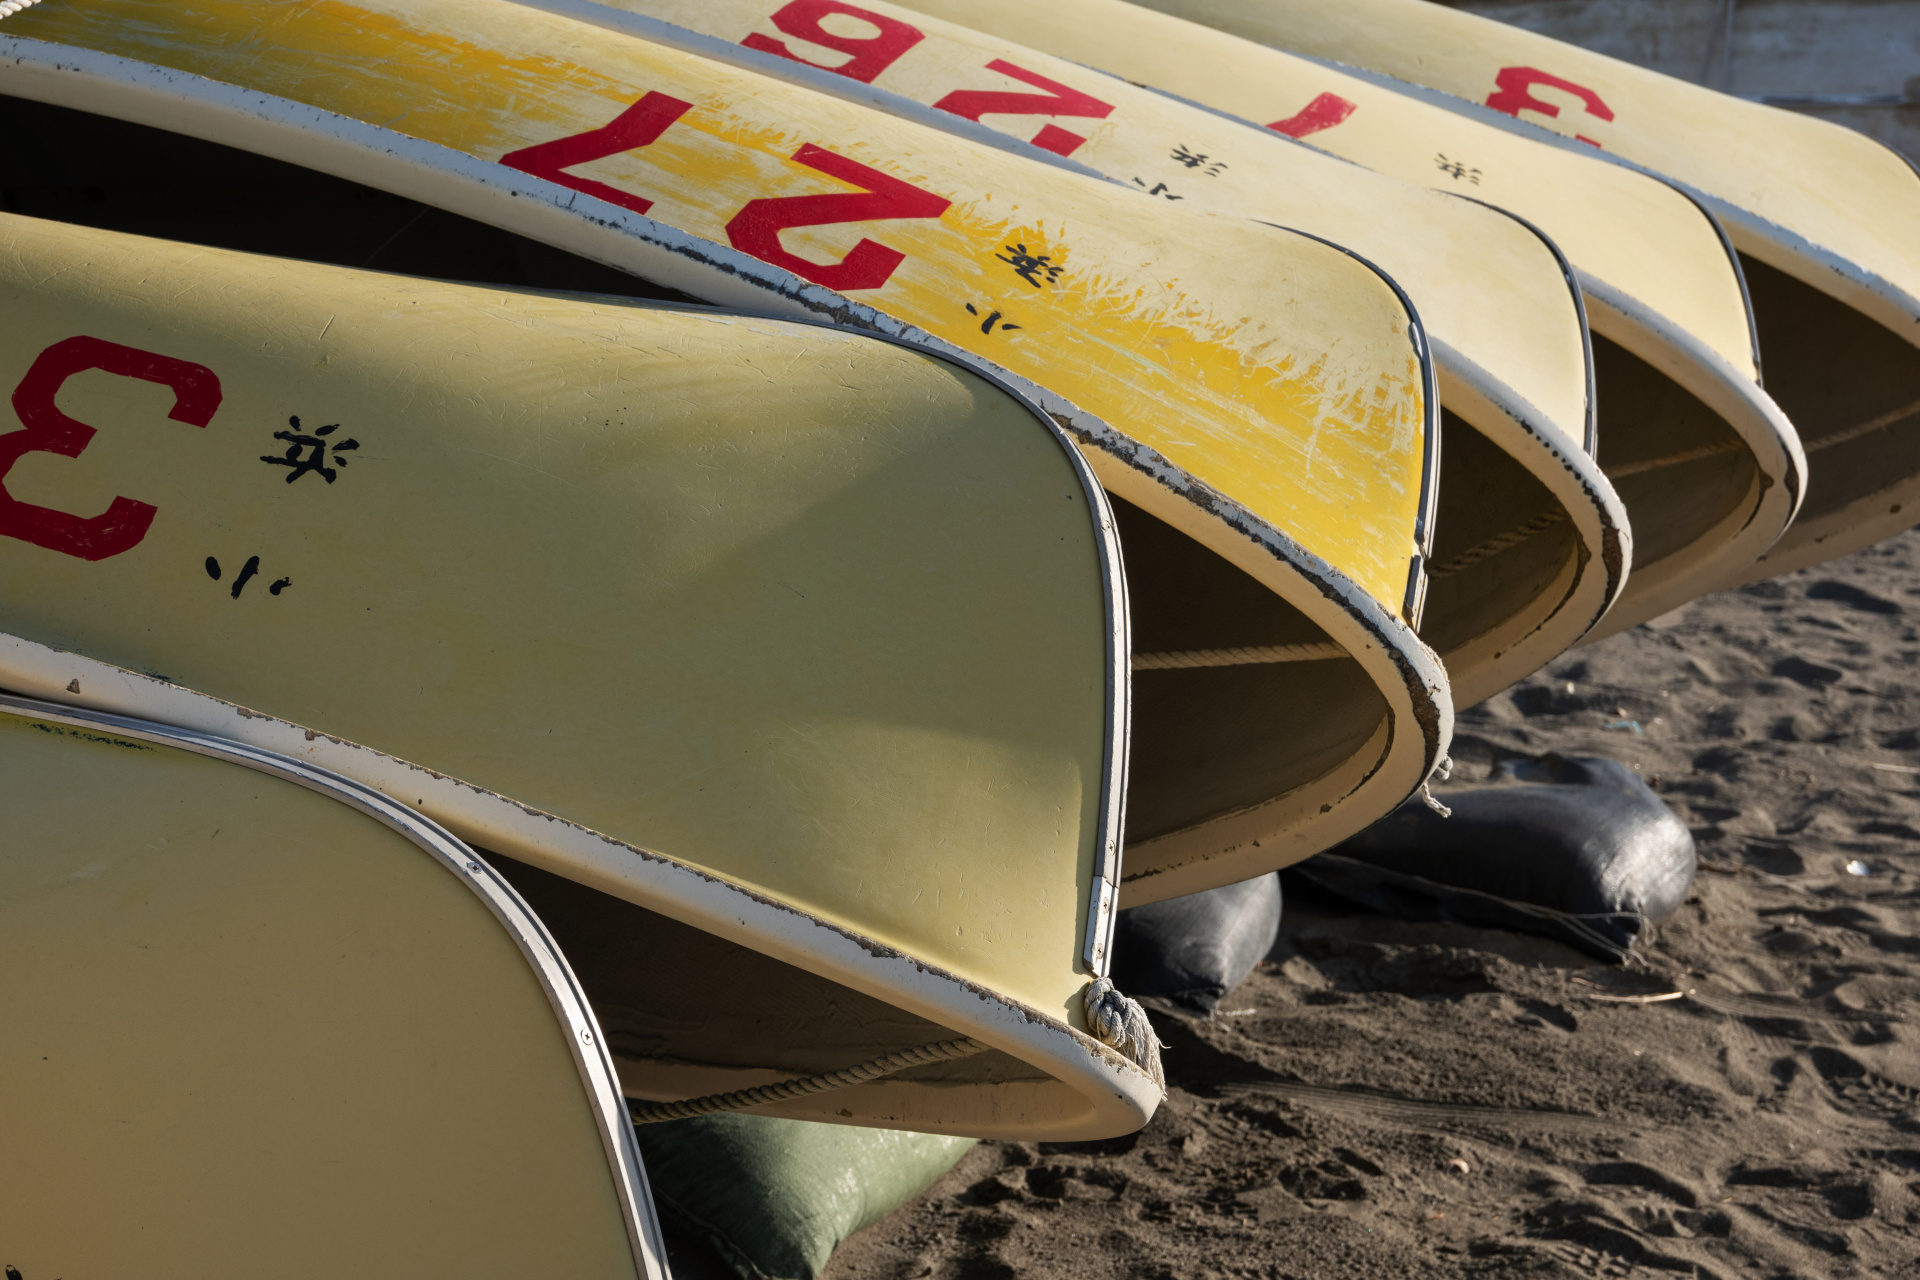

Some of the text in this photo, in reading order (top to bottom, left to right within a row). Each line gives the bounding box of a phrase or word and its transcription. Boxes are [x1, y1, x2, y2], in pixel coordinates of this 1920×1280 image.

[738, 0, 1116, 158] 26
[498, 90, 953, 291] 27
[965, 242, 1066, 335] 小浜
[204, 414, 361, 600] 小浜
